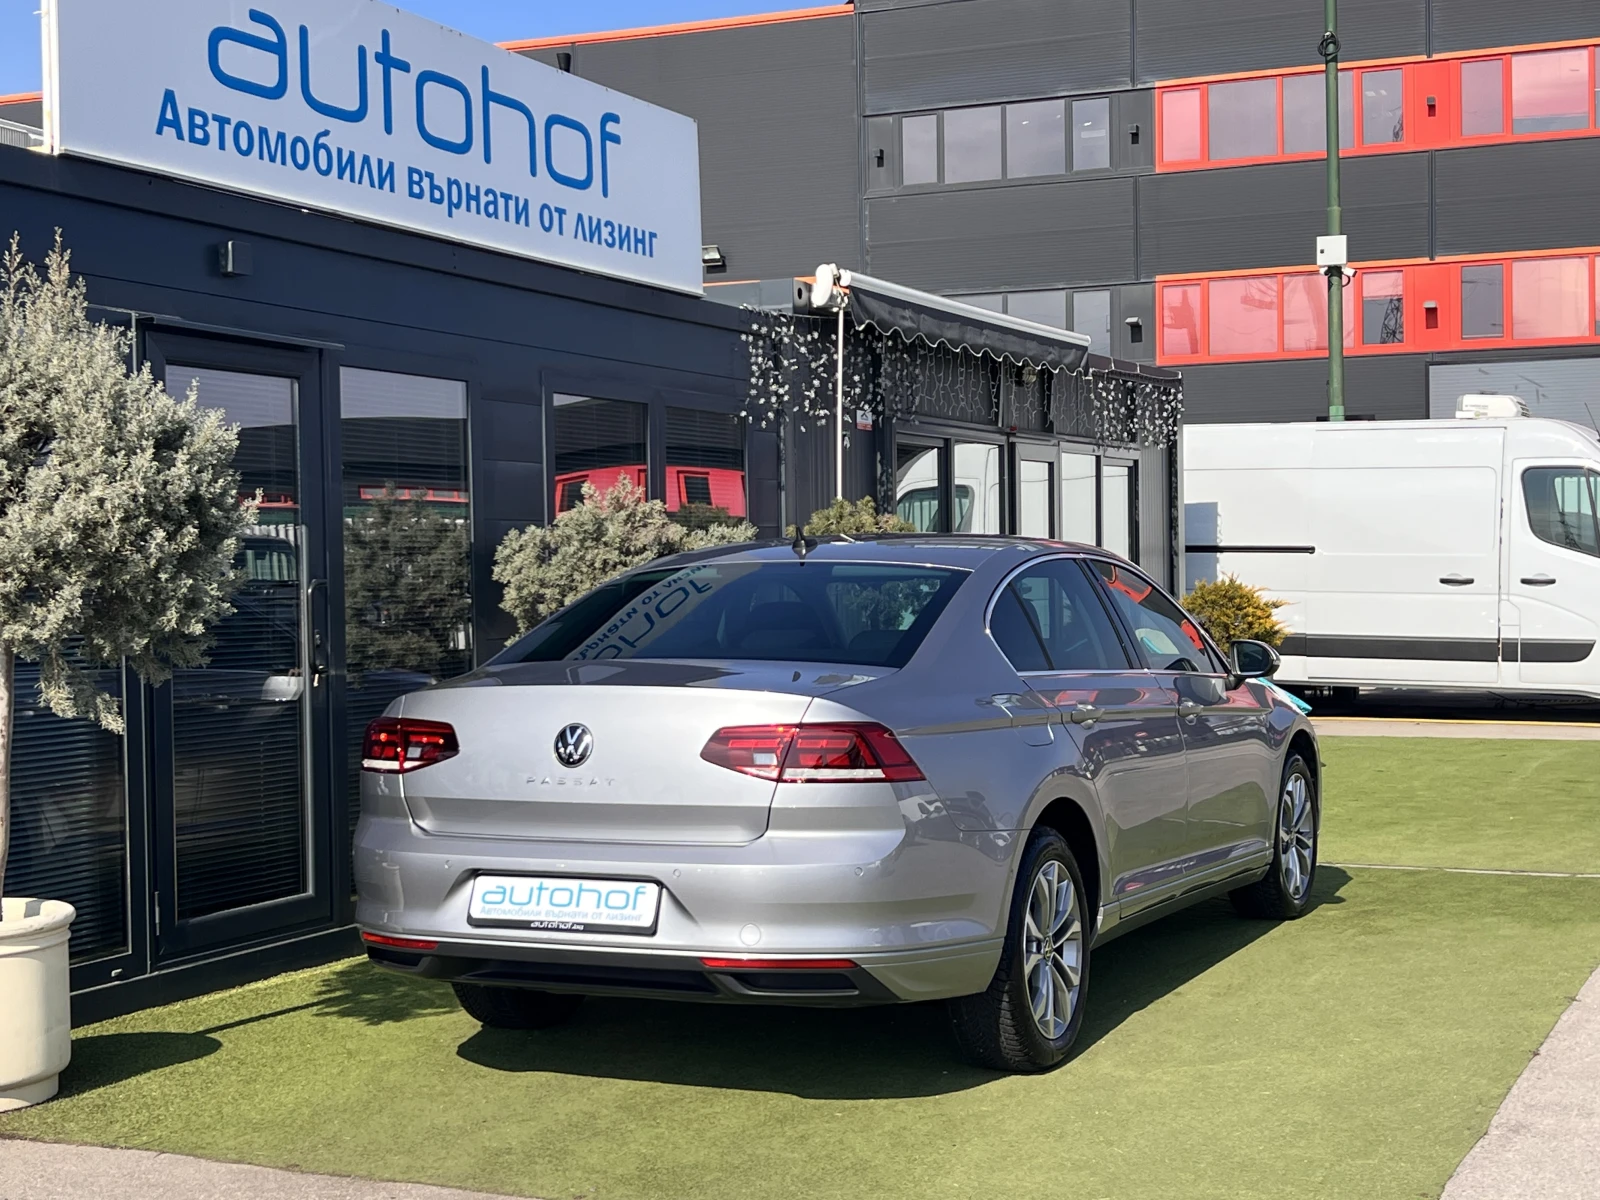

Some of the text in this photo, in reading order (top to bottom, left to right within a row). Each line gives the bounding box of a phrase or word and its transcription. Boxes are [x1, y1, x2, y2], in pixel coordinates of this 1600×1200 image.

[207, 8, 622, 199] autohof
[155, 88, 658, 258] Автомобили върнати от лизинг
[526, 776, 616, 786] PASSAT
[482, 882, 646, 910] autohof
[480, 905, 541, 917] Автомобили
[545, 909, 588, 918] върнати
